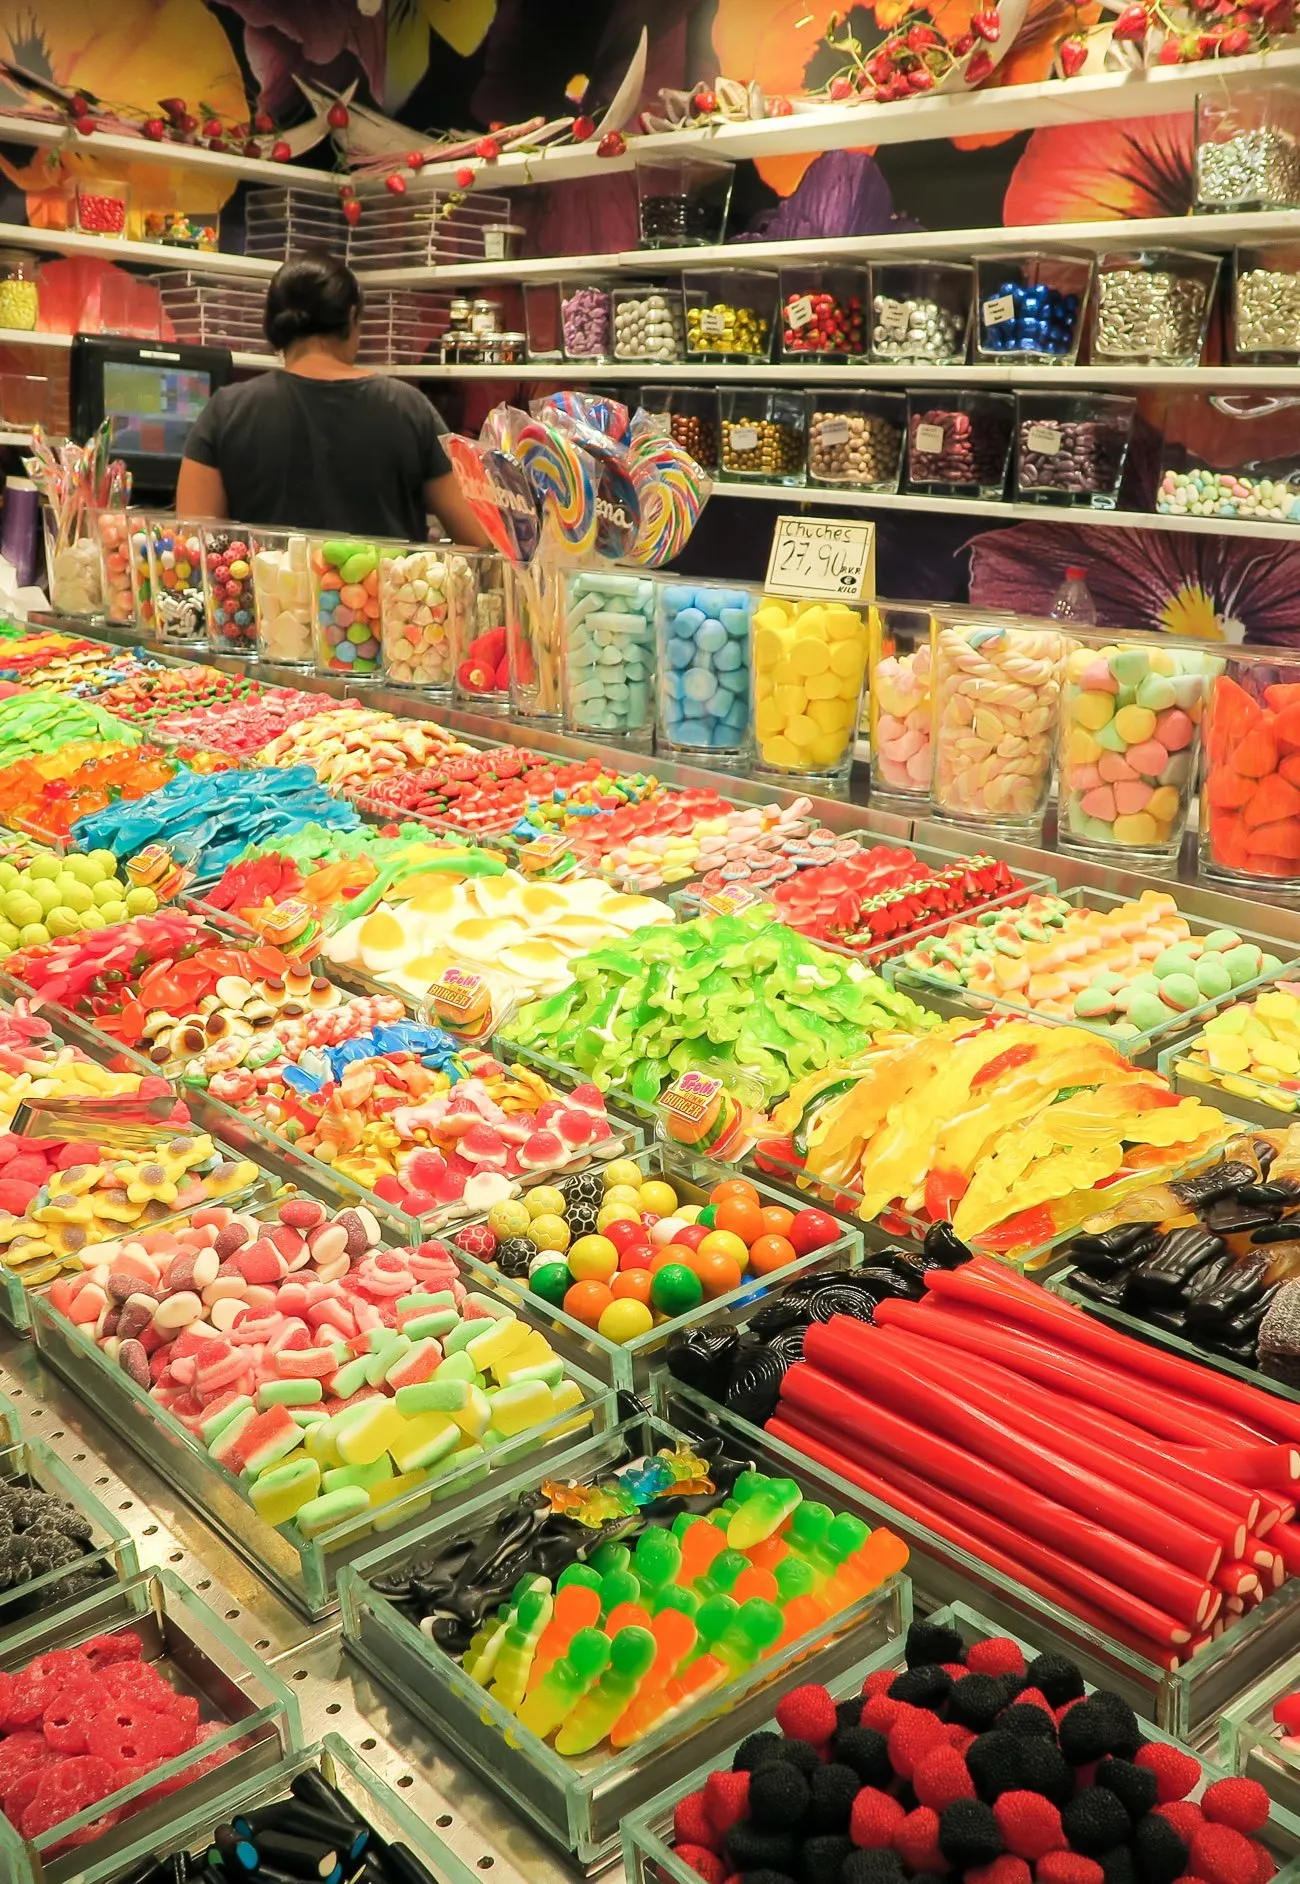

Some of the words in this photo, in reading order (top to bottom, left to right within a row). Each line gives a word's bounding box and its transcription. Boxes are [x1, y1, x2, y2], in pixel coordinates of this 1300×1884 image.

[785, 520, 852, 543] Chuches
[780, 539, 847, 577] 27,90
[837, 586, 858, 594] KILO
[443, 968, 481, 988] Trolli
[428, 985, 469, 1006] BURGER
[679, 1073, 719, 1096] Trolli
[662, 1092, 703, 1118] BURGER
